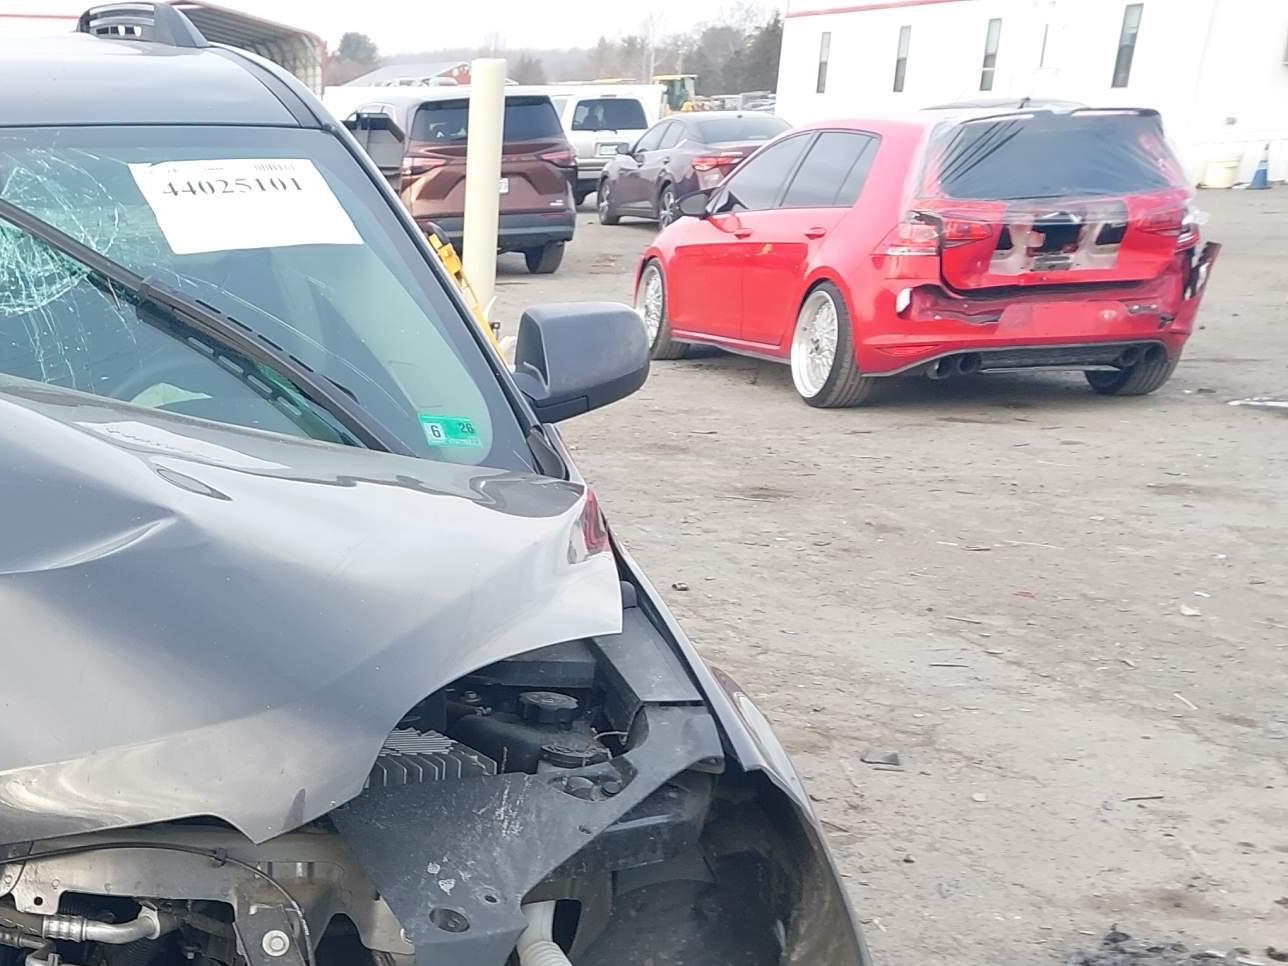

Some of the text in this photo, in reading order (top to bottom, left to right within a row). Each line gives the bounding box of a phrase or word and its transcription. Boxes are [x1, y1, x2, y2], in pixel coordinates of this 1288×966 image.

[162, 177, 302, 197] 44025101
[430, 422, 476, 439] 6 26
